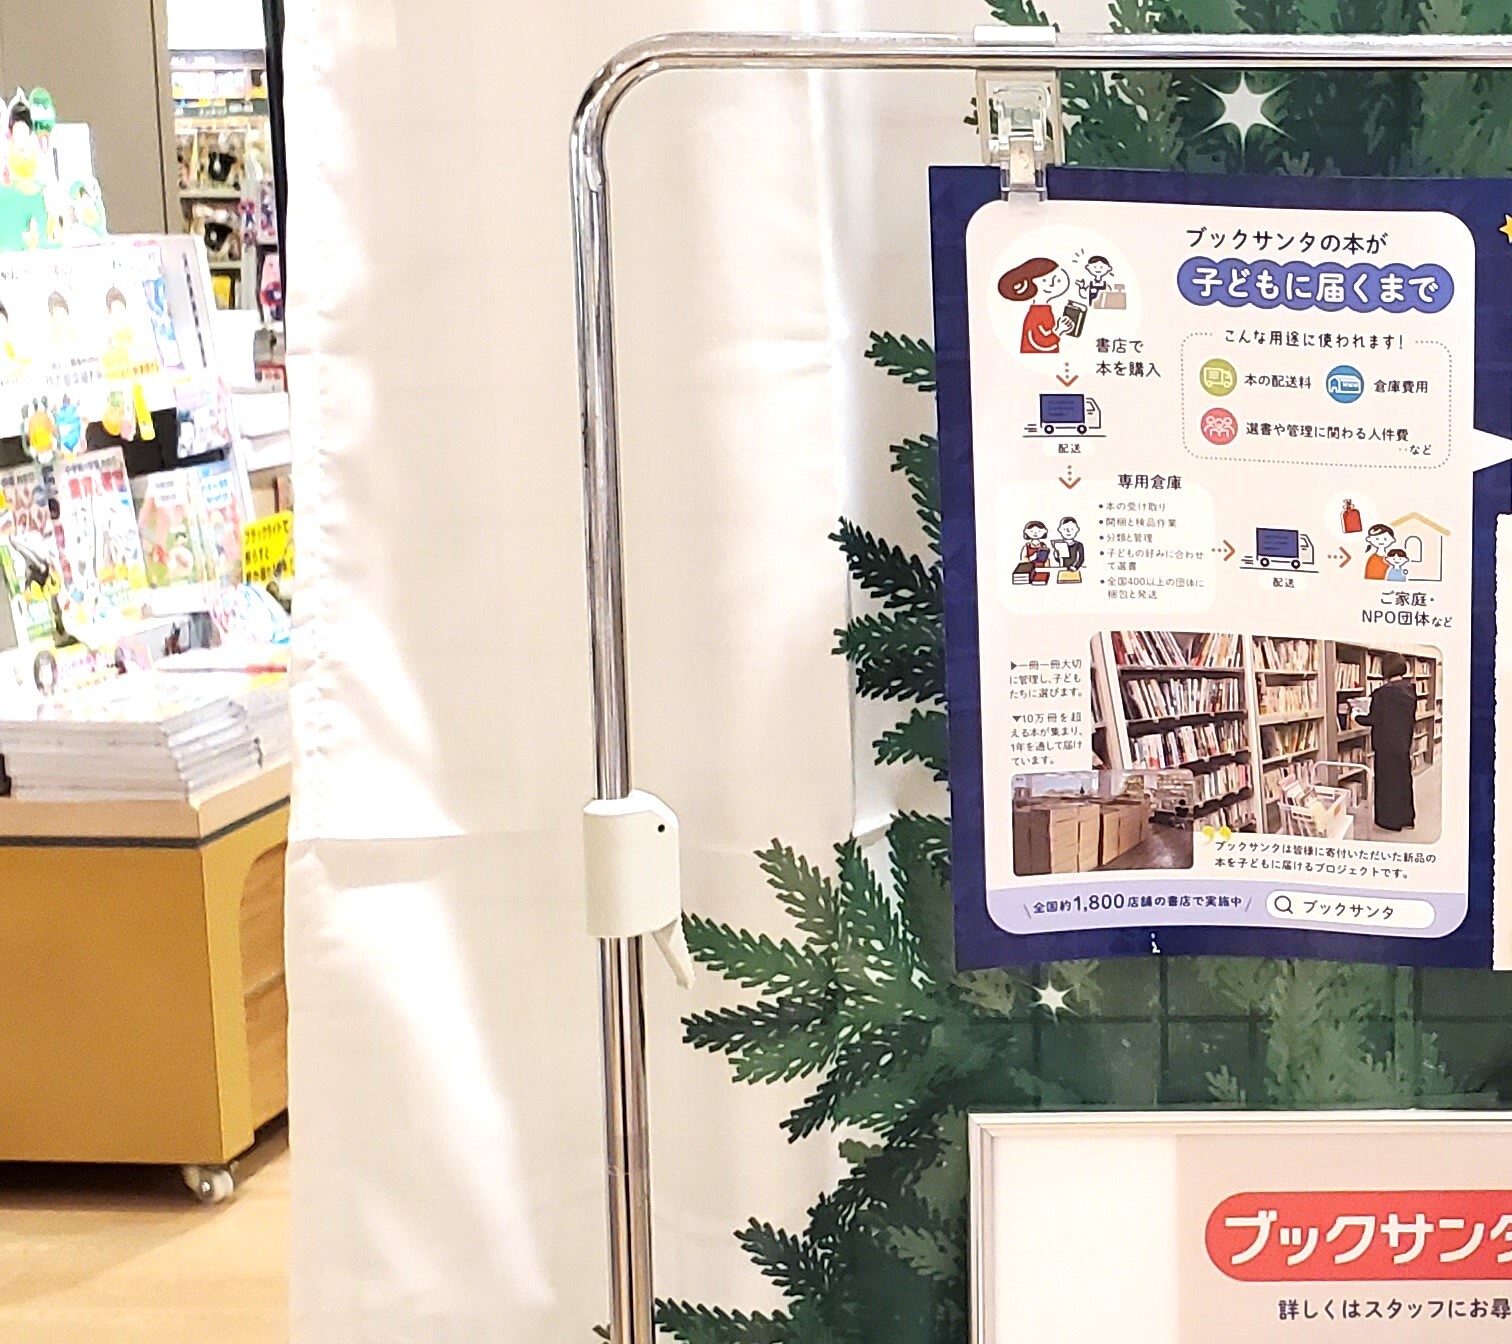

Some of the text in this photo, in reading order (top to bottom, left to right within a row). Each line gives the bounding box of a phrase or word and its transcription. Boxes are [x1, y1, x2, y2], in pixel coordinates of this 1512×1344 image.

[1185, 227, 1388, 255] ブックサンタの本が
[1192, 268, 1439, 304] 子どもに届くまで
[1096, 338, 1143, 354] 書店で
[1096, 360, 1161, 378] 本を購入
[1243, 372, 1312, 391] 本の配送料
[1373, 378, 1429, 395] 倉庫費用
[1246, 422, 1409, 443] 選書や管理に関わる人件費
[1057, 443, 1082, 455] 配送
[1118, 474, 1182, 490] 専用倉庫
[1106, 501, 1166, 512] 本の受け取り
[1106, 548, 1204, 560] 子どもの好みに合わせ
[1272, 577, 1295, 589] 配送
[1361, 609, 1453, 629] NPO団体など
[1011, 756, 1055, 766] ています。
[1215, 841, 1436, 863] ブックサンタは皆様に寄付いただいた新品の
[1214, 857, 1408, 879] 本を子どもに届けるプロジェクトです。
[1033, 893, 1242, 914] 全国約1,800店舗の書店で実施中
[1303, 901, 1394, 920] ブックサンタ
